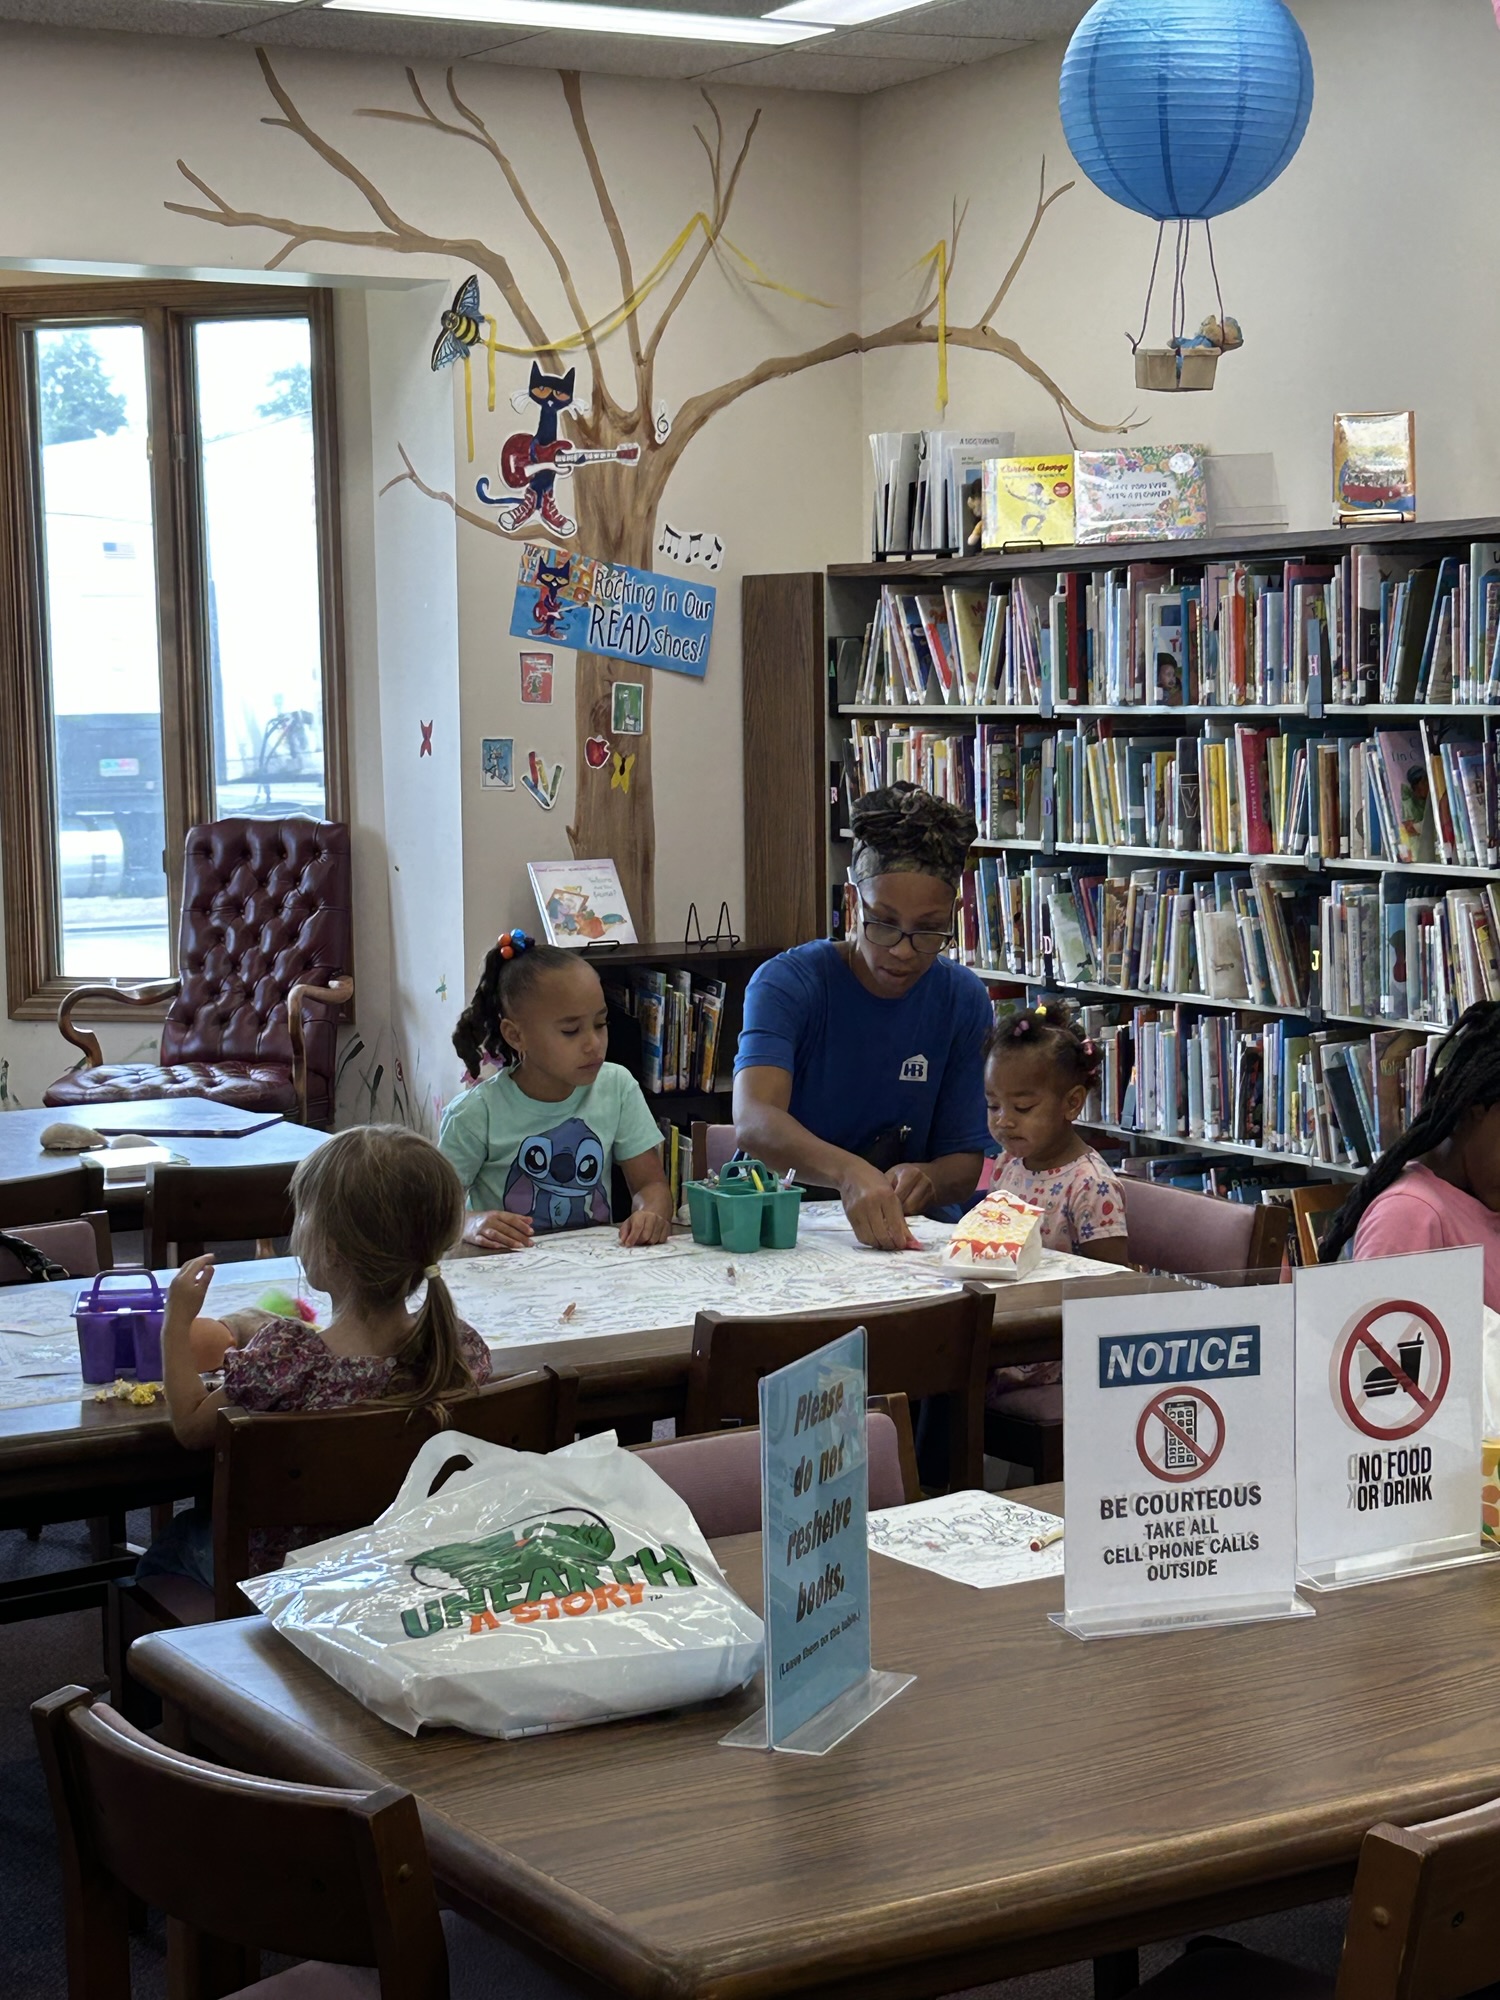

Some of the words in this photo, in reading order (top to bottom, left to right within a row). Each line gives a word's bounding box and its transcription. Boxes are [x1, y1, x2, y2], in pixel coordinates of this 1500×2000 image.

[594, 570, 655, 612] Rocking
[663, 585, 677, 612] in
[684, 592, 712, 619] Our
[590, 604, 650, 655] READ
[1308, 654, 1319, 676] H
[1043, 936, 1052, 955] D
[1311, 950, 1320, 971] J
[1108, 1335, 1253, 1380] NOTICE
[794, 1381, 844, 1436] Please
[794, 1454, 812, 1497] do
[819, 1437, 846, 1484] not
[1359, 1454, 1382, 1483] NO
[1388, 1447, 1432, 1478] FOOD
[1101, 1498, 1128, 1520] BE
[1135, 1485, 1262, 1517] COURTEOUS
[1357, 1485, 1379, 1511] OR
[1383, 1475, 1432, 1507] DRINK
[787, 1495, 852, 1566] reshelve
[1145, 1520, 1185, 1540] TAKE
[1190, 1517, 1219, 1536] ALL
[1104, 1546, 1143, 1565] CELL
[1149, 1540, 1204, 1562] PHONE
[1210, 1534, 1260, 1554] CALLS
[1147, 1559, 1217, 1582] OUTSIDE
[401, 1544, 698, 1639] UNEARTH
[470, 1610, 500, 1634] A
[510, 1583, 647, 1623] STORY
[796, 1562, 845, 1623] books.
